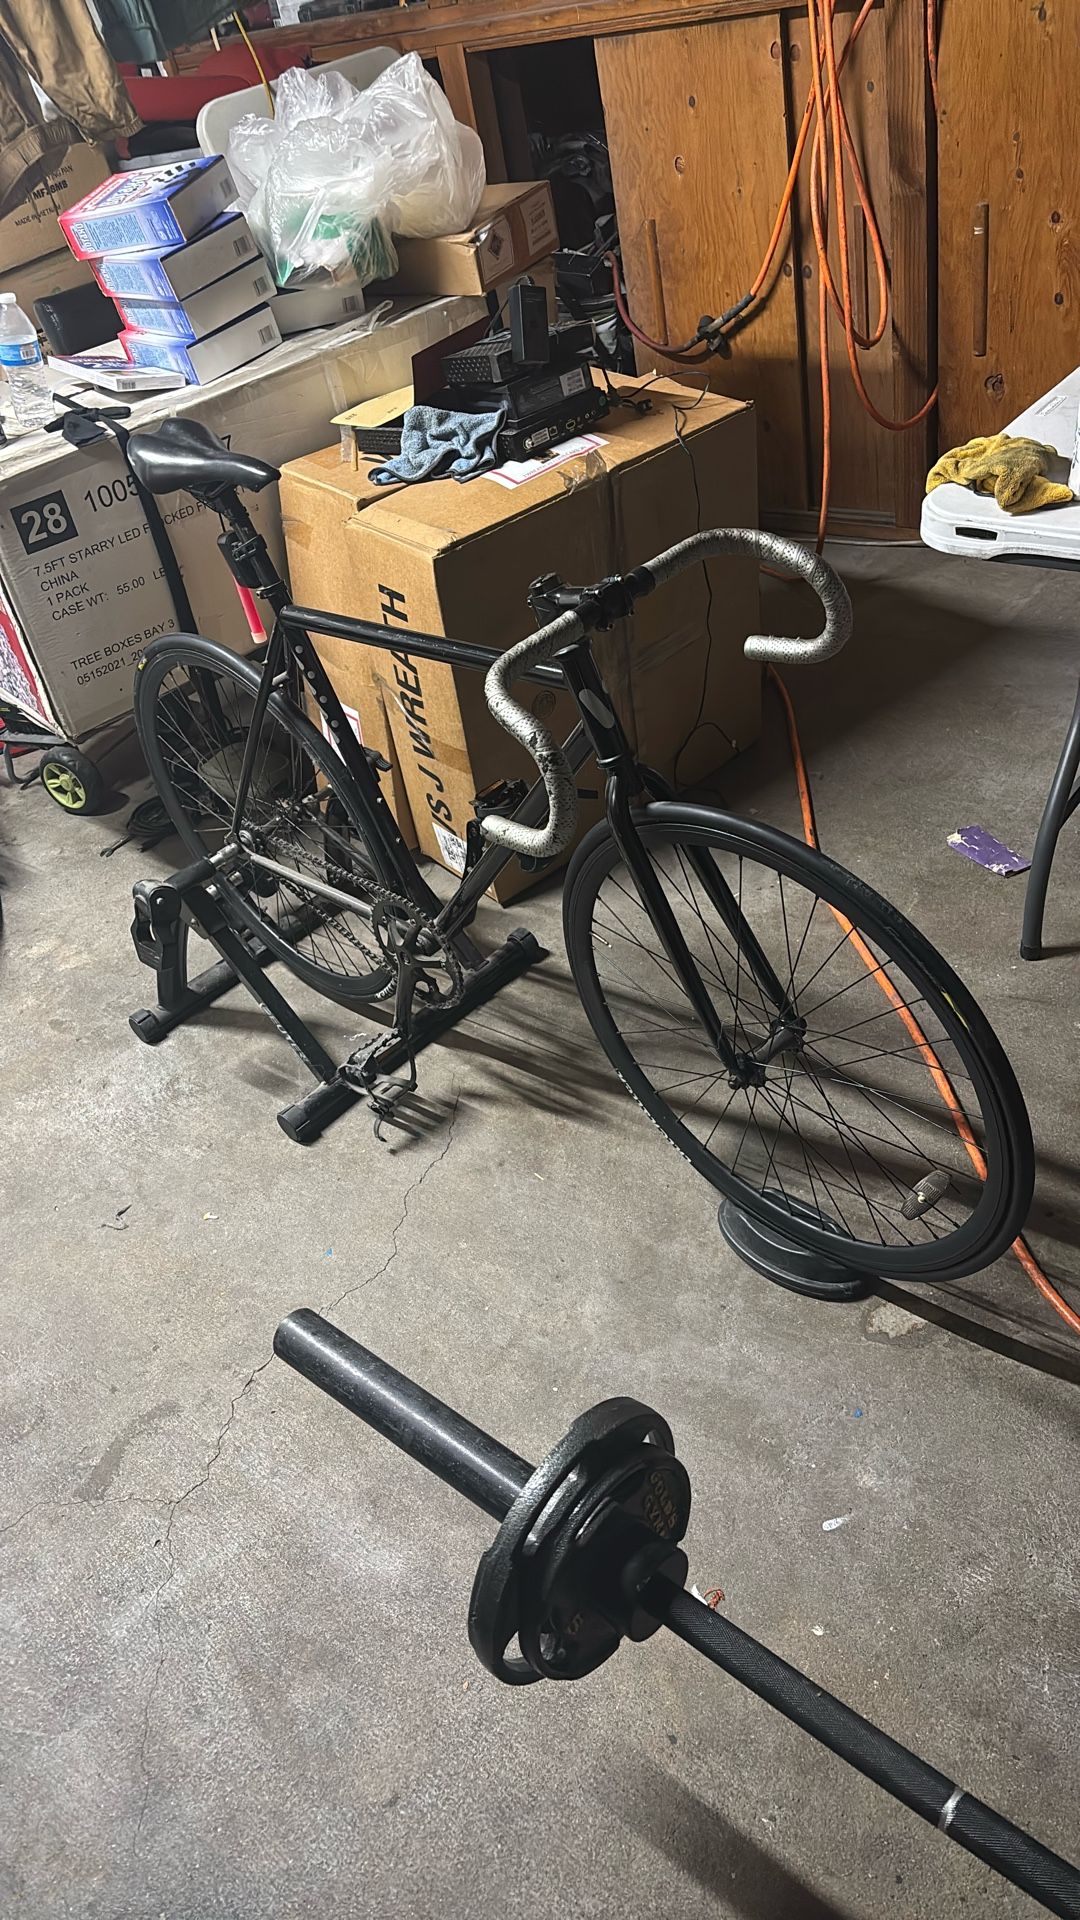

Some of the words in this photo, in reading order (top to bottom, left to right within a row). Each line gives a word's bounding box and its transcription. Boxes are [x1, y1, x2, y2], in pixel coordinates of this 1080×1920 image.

[21, 502, 68, 545] 28
[33, 557, 65, 577] 7.5FT
[69, 538, 115, 564] STARRY
[119, 527, 141, 544] LED
[40, 570, 79, 592] CHINA
[47, 596, 53, 607] 1
[56, 582, 90, 603] PACK
[52, 601, 85, 621] CASE
[86, 592, 109, 608] WT:
[116, 576, 146, 595] 55.00
[70, 650, 103, 671] TREE
[104, 633, 142, 657] BOXES
[144, 621, 166, 640] BAY
[168, 618, 175, 628] 3
[378, 583, 435, 760] WREAH
[418, 764, 446, 794] J
